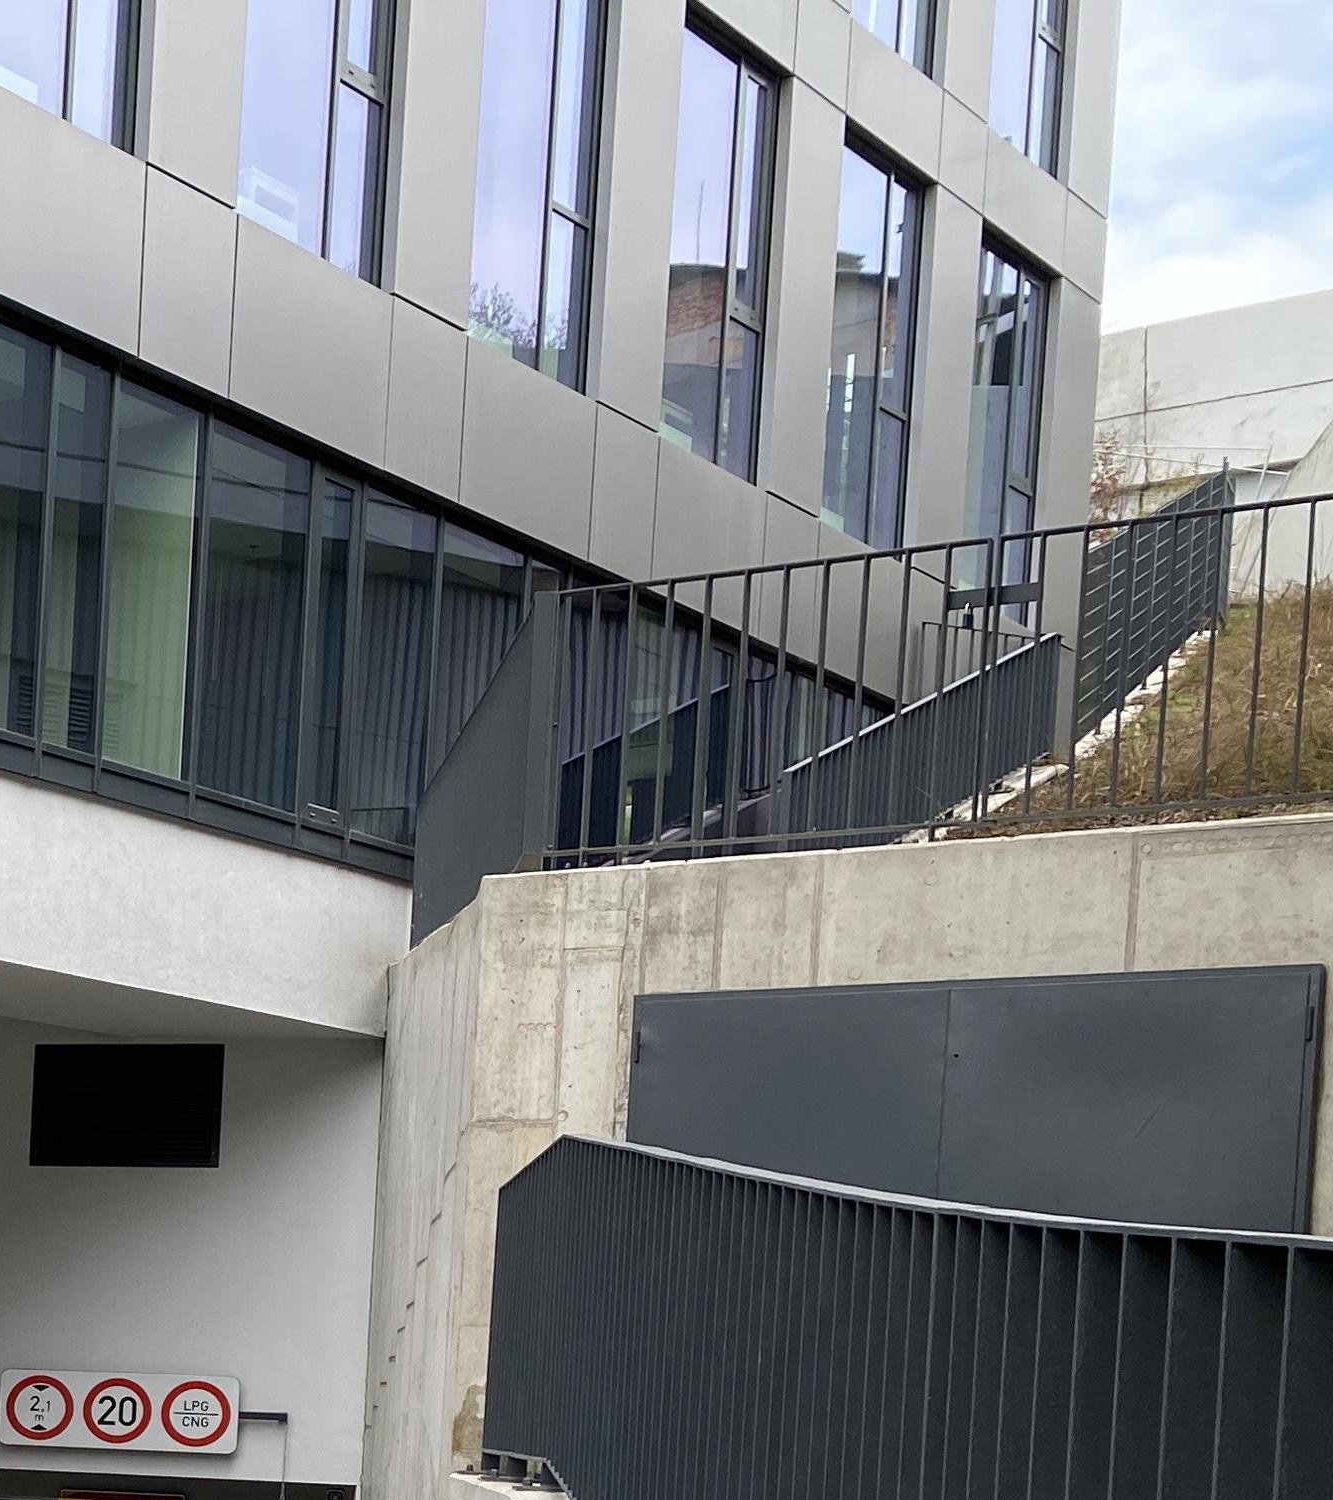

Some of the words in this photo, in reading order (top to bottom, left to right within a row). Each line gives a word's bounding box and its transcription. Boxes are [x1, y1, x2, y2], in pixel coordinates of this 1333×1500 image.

[97, 1395, 137, 1427] 20
[183, 1400, 209, 1412] LPG
[34, 1414, 45, 1422] m
[181, 1416, 210, 1428] CNG
